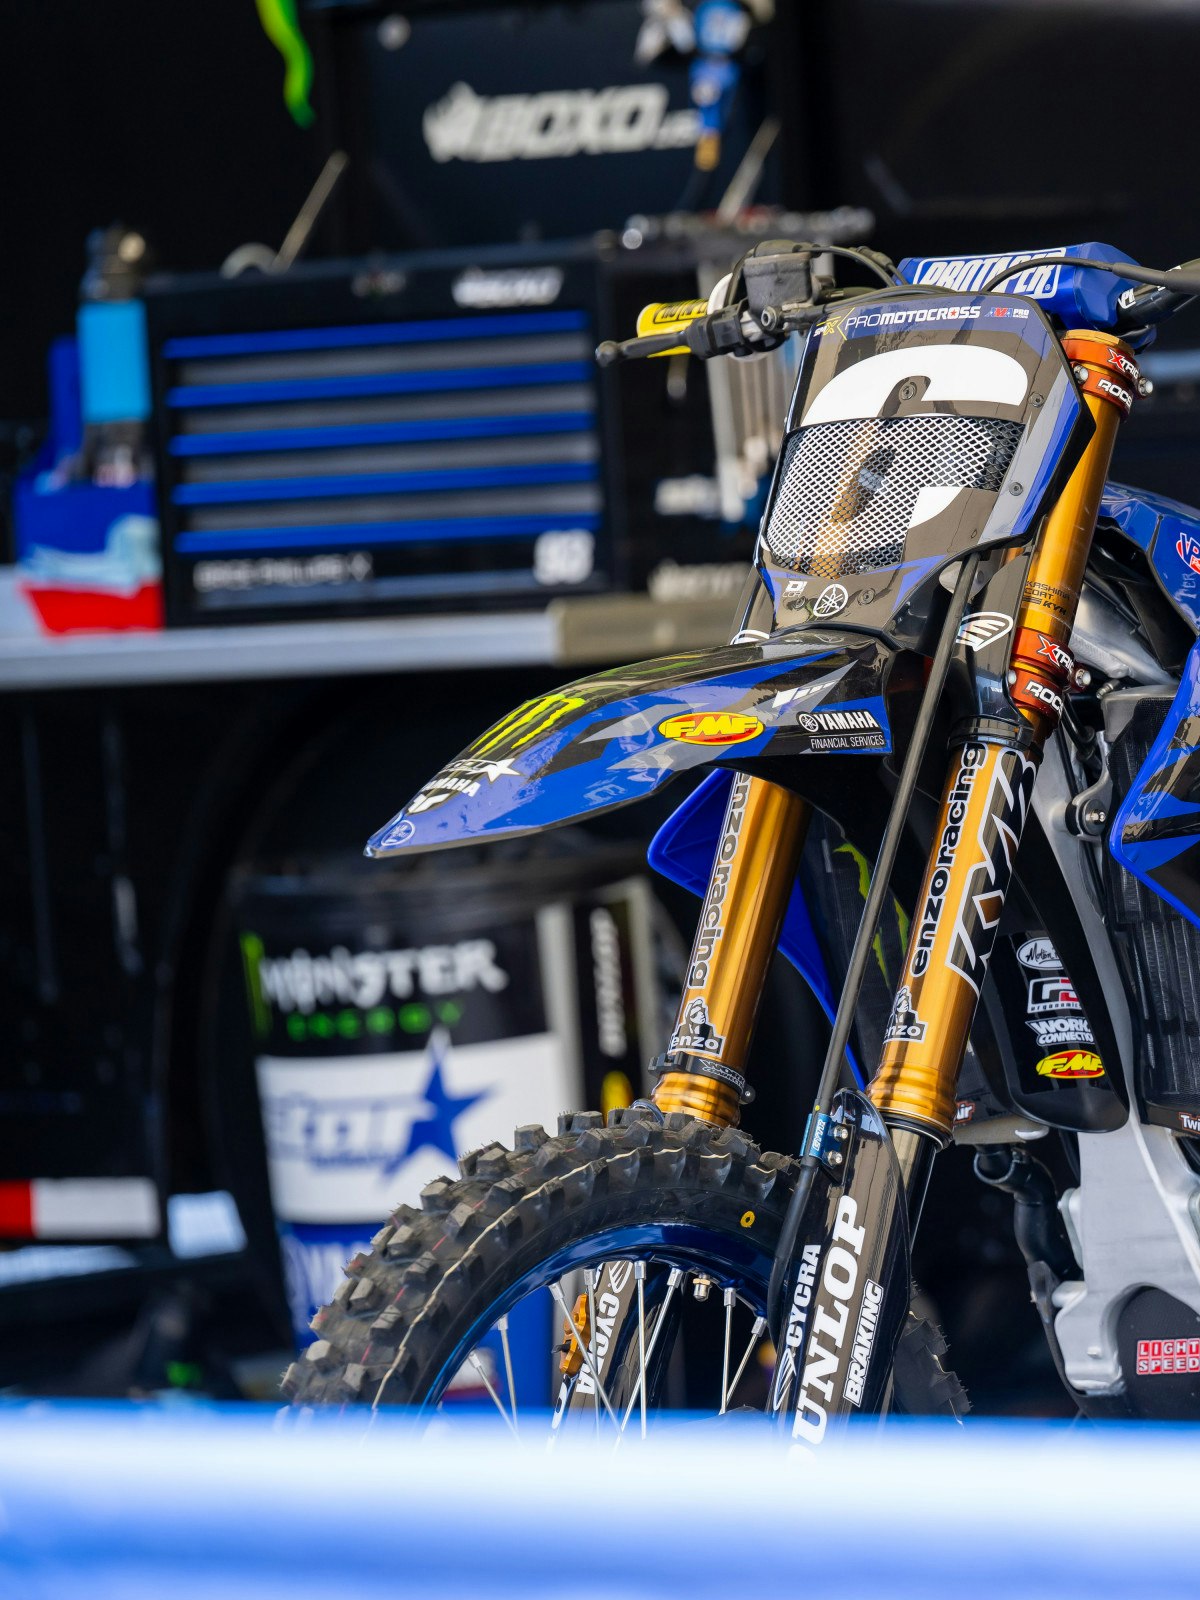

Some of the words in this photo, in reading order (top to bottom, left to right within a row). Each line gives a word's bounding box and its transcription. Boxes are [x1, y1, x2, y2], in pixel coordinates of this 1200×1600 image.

[665, 714, 758, 738] FMF
[816, 711, 879, 731] YAMAHA
[810, 736, 850, 749] FINANCIAL
[850, 734, 885, 748] SERVICES
[911, 743, 986, 976] enzoracing
[671, 1035, 719, 1051] enzo
[785, 1244, 822, 1348] CYCRA
[843, 1281, 883, 1406] BRAKING
[1138, 1339, 1200, 1357] LIGHT
[1138, 1357, 1200, 1374] SPEED
